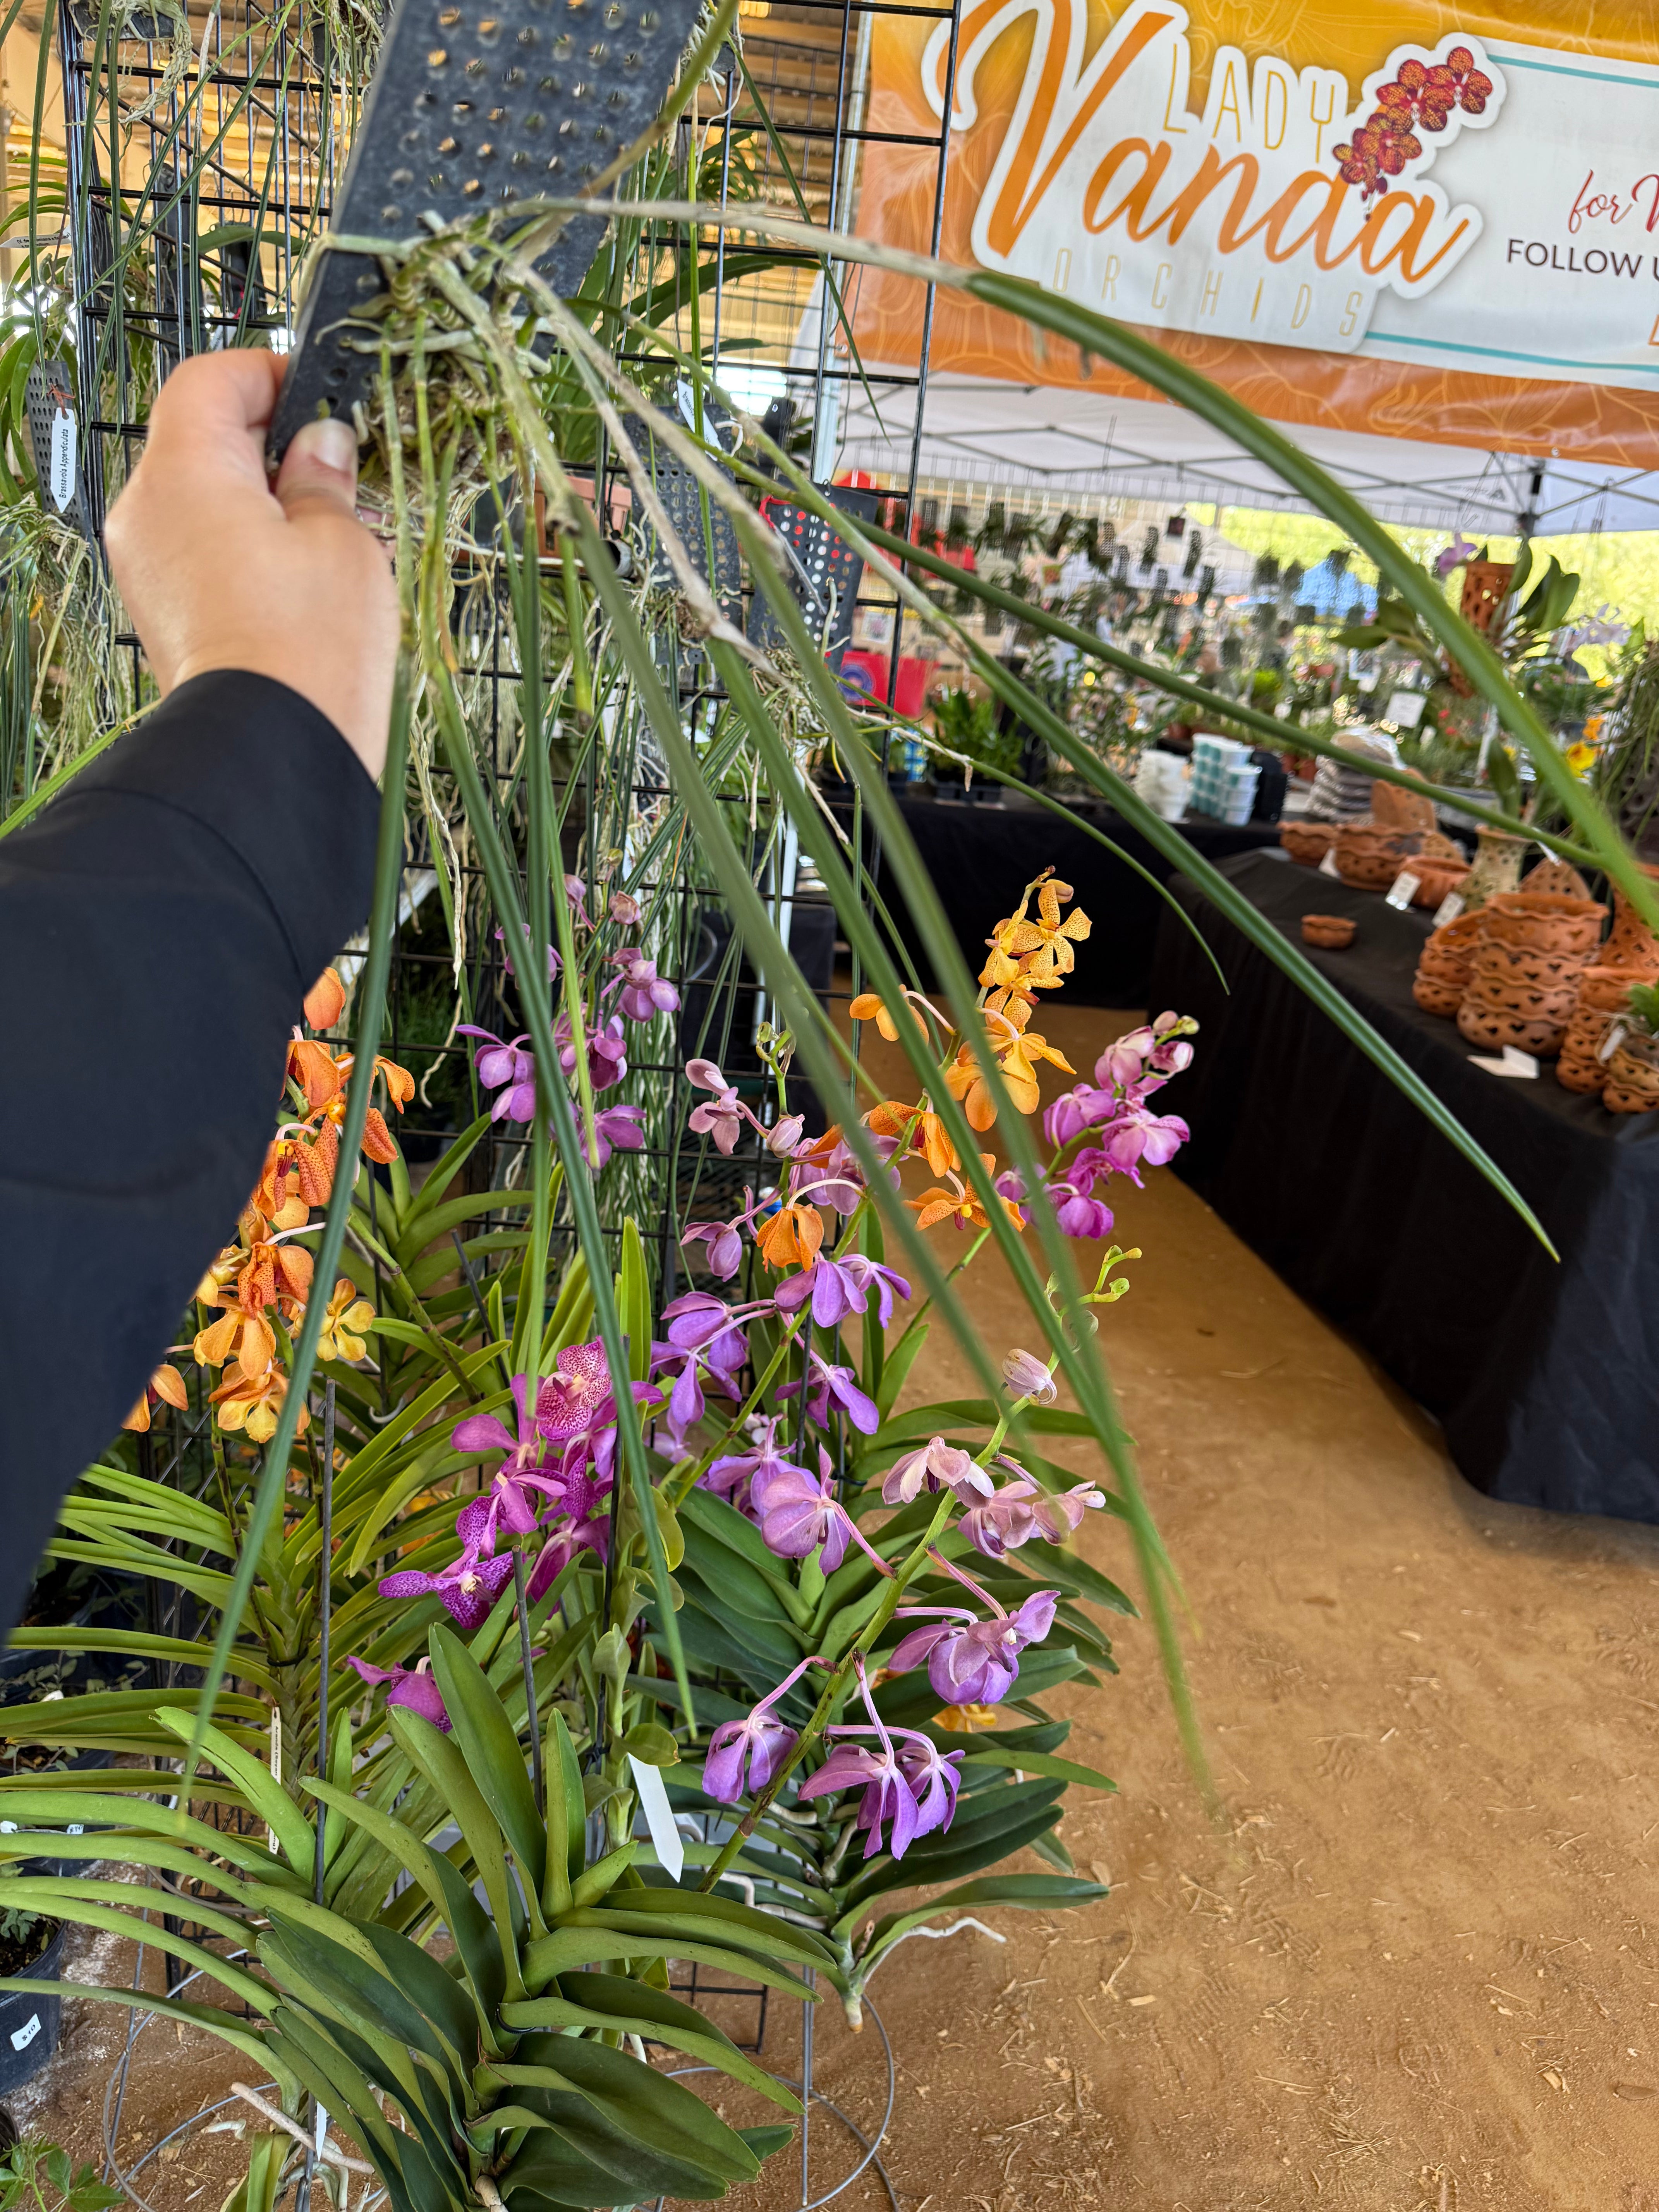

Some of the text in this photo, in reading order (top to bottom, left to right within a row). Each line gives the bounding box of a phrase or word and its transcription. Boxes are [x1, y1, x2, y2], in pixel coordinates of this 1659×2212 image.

[936, 0, 1470, 283] Vanda
[1163, 43, 1334, 163] LADY
[1568, 169, 1633, 234] for
[1053, 247, 1363, 336] ORCHIDS
[1506, 238, 1644, 279] FOLLOW
[22, 2025, 35, 2041] $10
